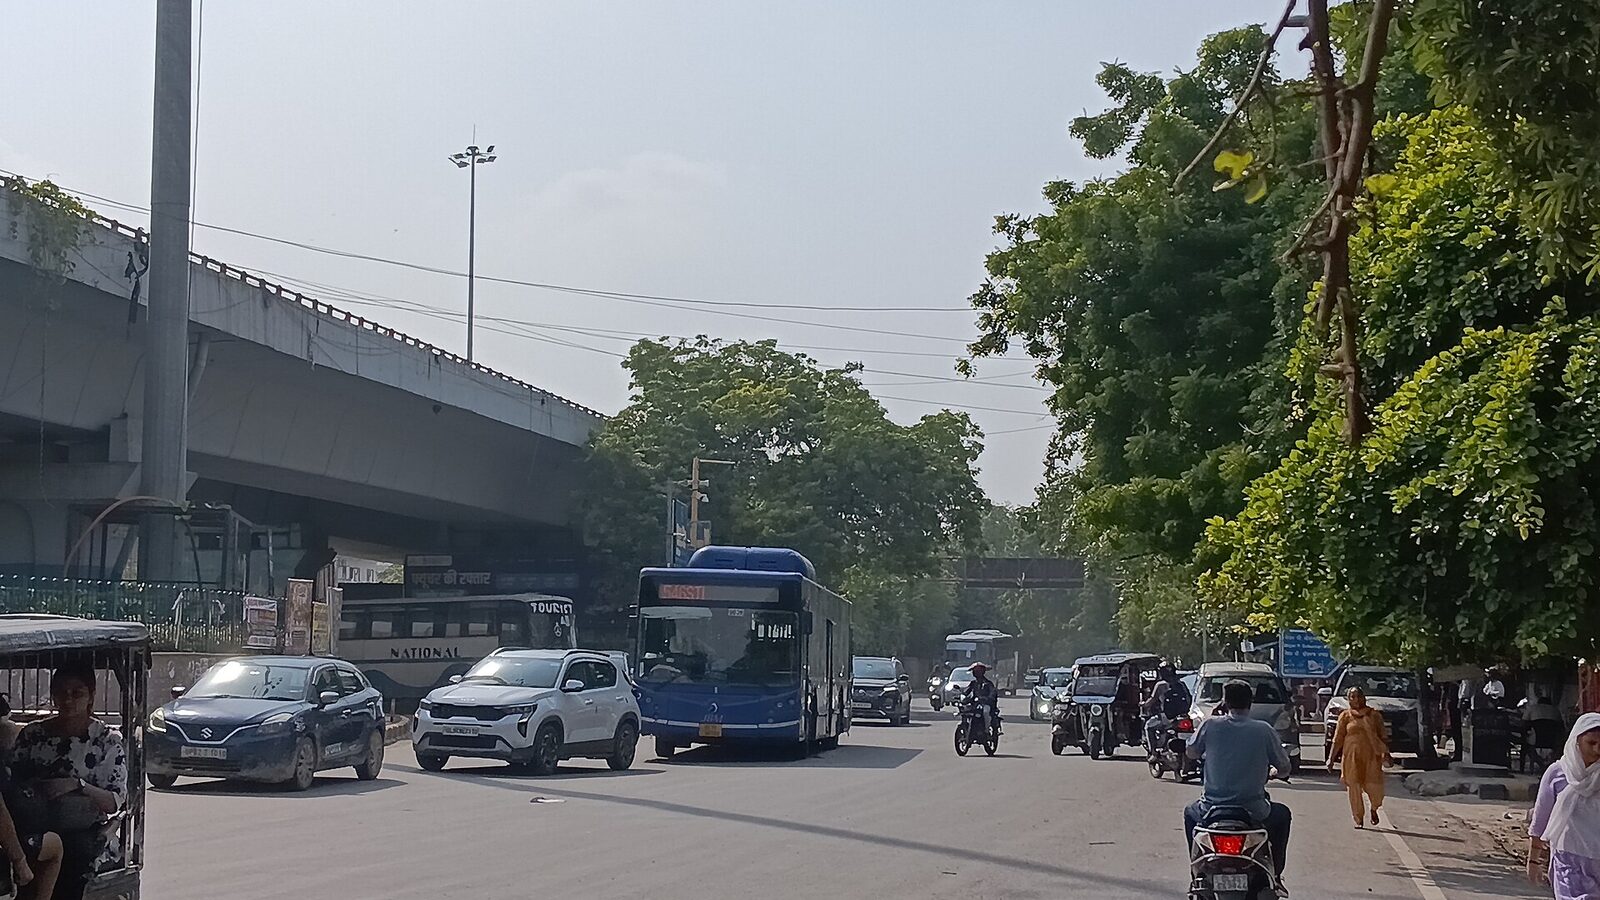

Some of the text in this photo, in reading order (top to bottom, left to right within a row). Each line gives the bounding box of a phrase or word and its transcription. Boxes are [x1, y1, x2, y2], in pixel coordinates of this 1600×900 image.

[443, 569, 456, 584] की
[459, 572, 491, 585] रफ्तार
[530, 602, 573, 614] TOURIST
[390, 646, 461, 659] NATIONAL
